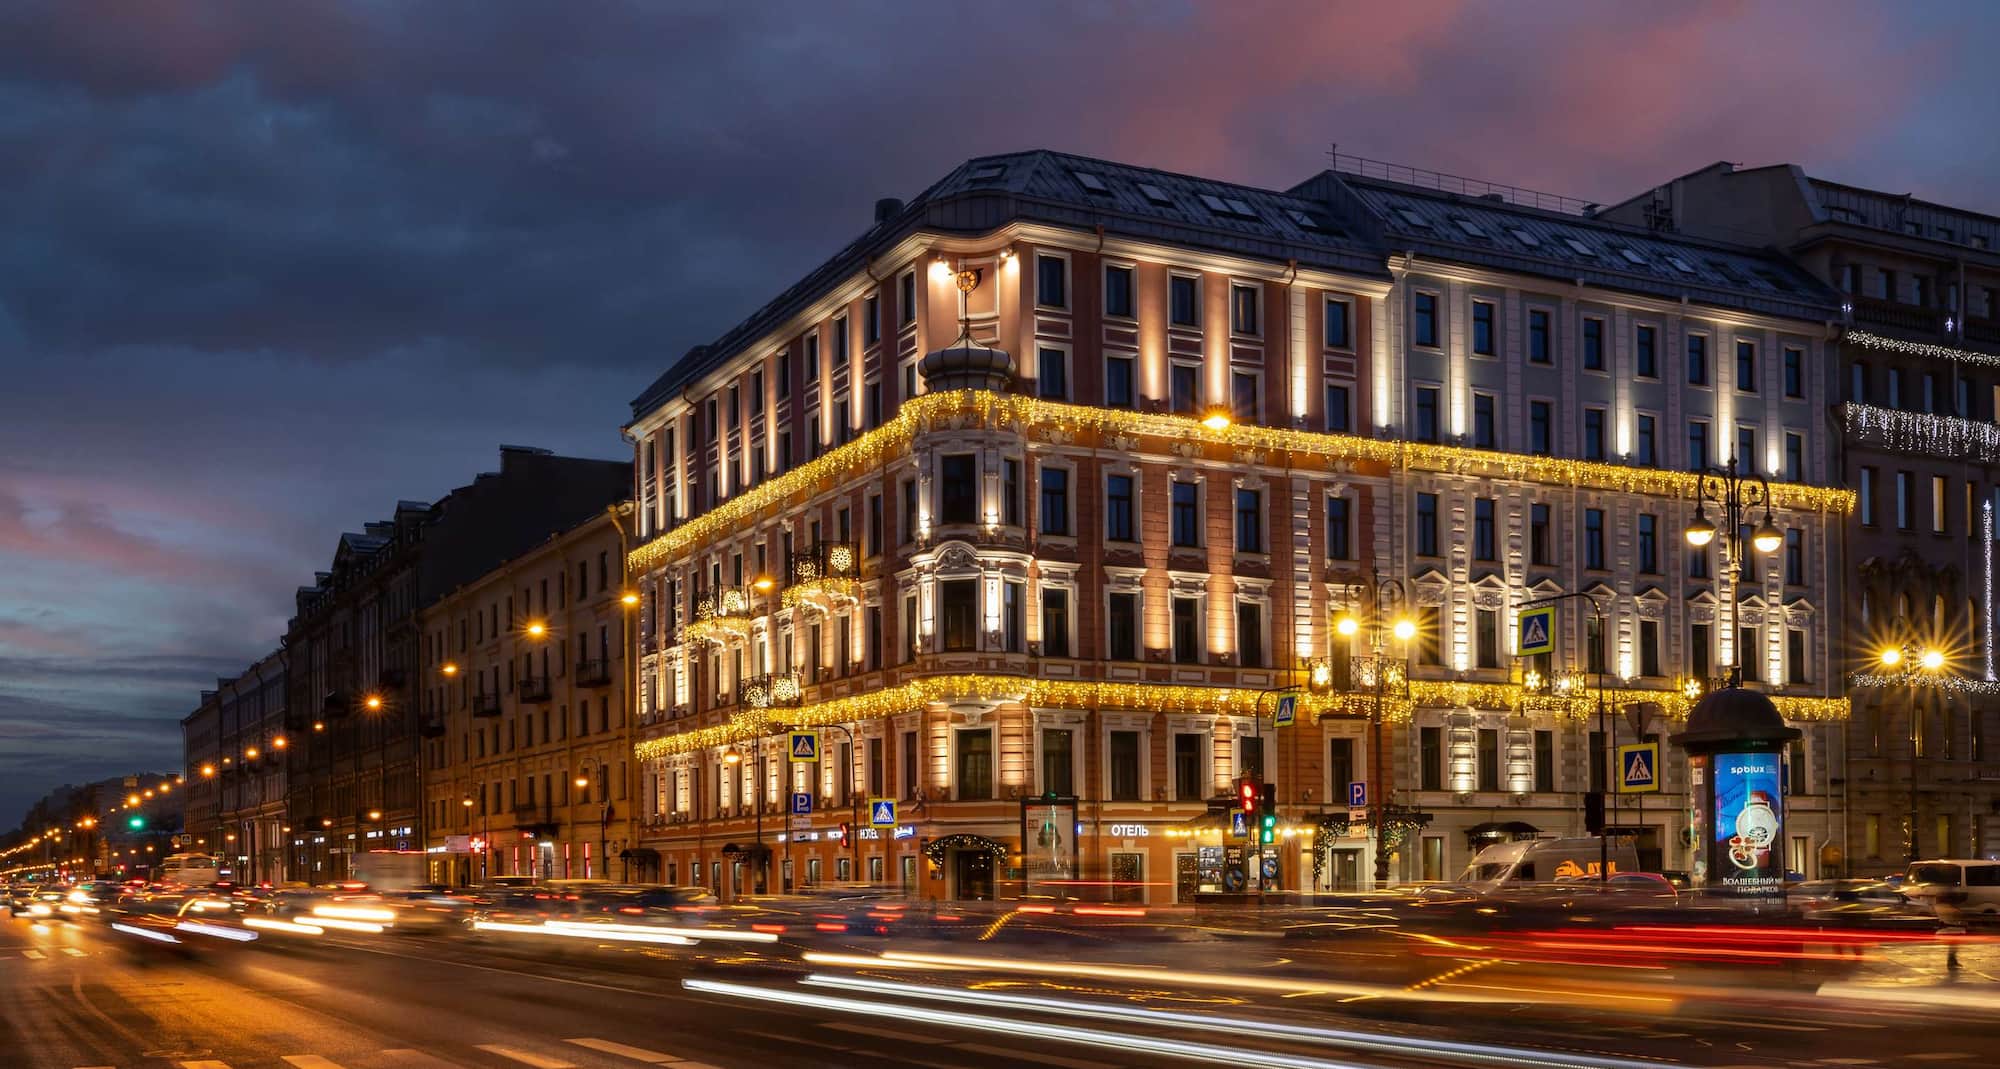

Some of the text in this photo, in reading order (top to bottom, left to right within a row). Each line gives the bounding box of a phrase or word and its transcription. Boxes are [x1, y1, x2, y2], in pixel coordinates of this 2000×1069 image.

[1353, 784, 1364, 805] P
[796, 795, 808, 812] P
[1111, 824, 1149, 837] ОТЕЛЬ
[1722, 876, 1774, 886] ВОЛШЕБНЫЙ
